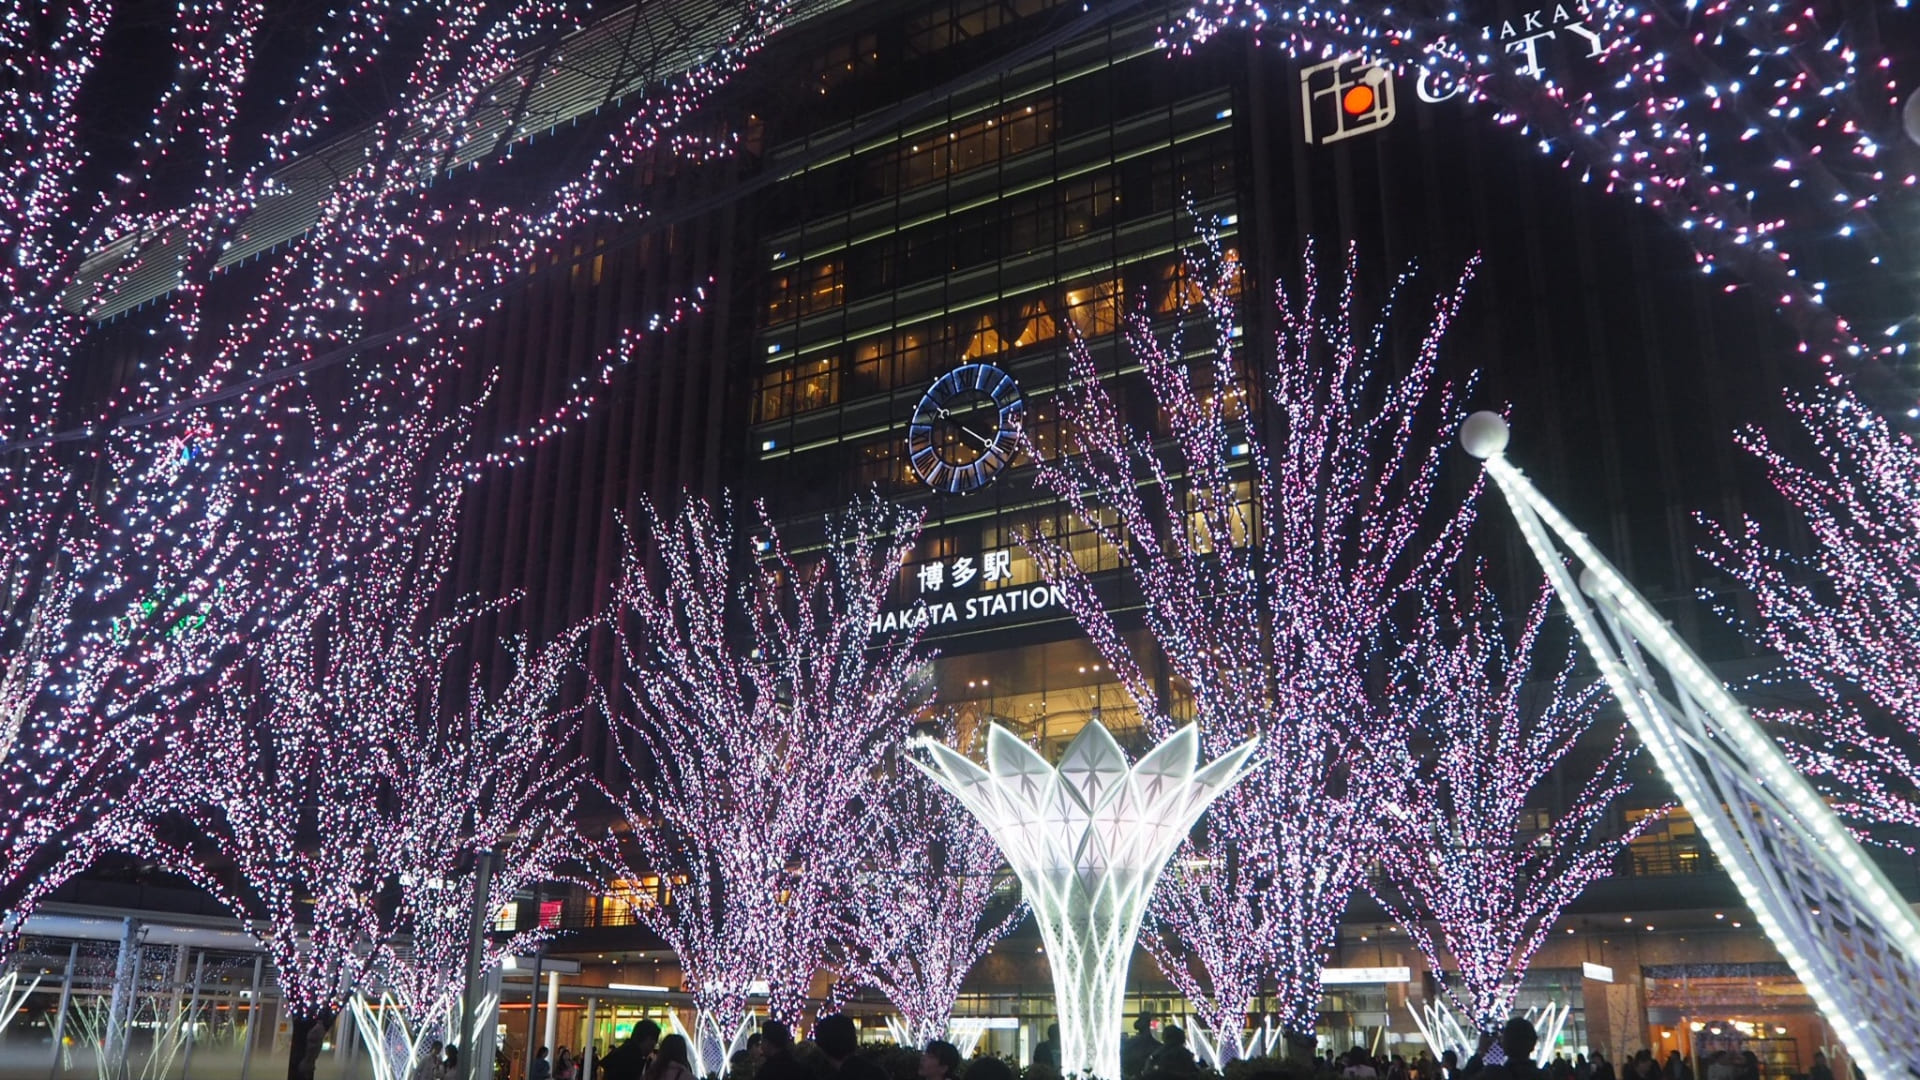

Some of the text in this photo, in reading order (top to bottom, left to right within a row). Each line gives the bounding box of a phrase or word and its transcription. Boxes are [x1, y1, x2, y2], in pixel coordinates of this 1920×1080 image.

[916, 550, 1013, 593] 博多駅
[868, 583, 1067, 634] HAKATA STATION
